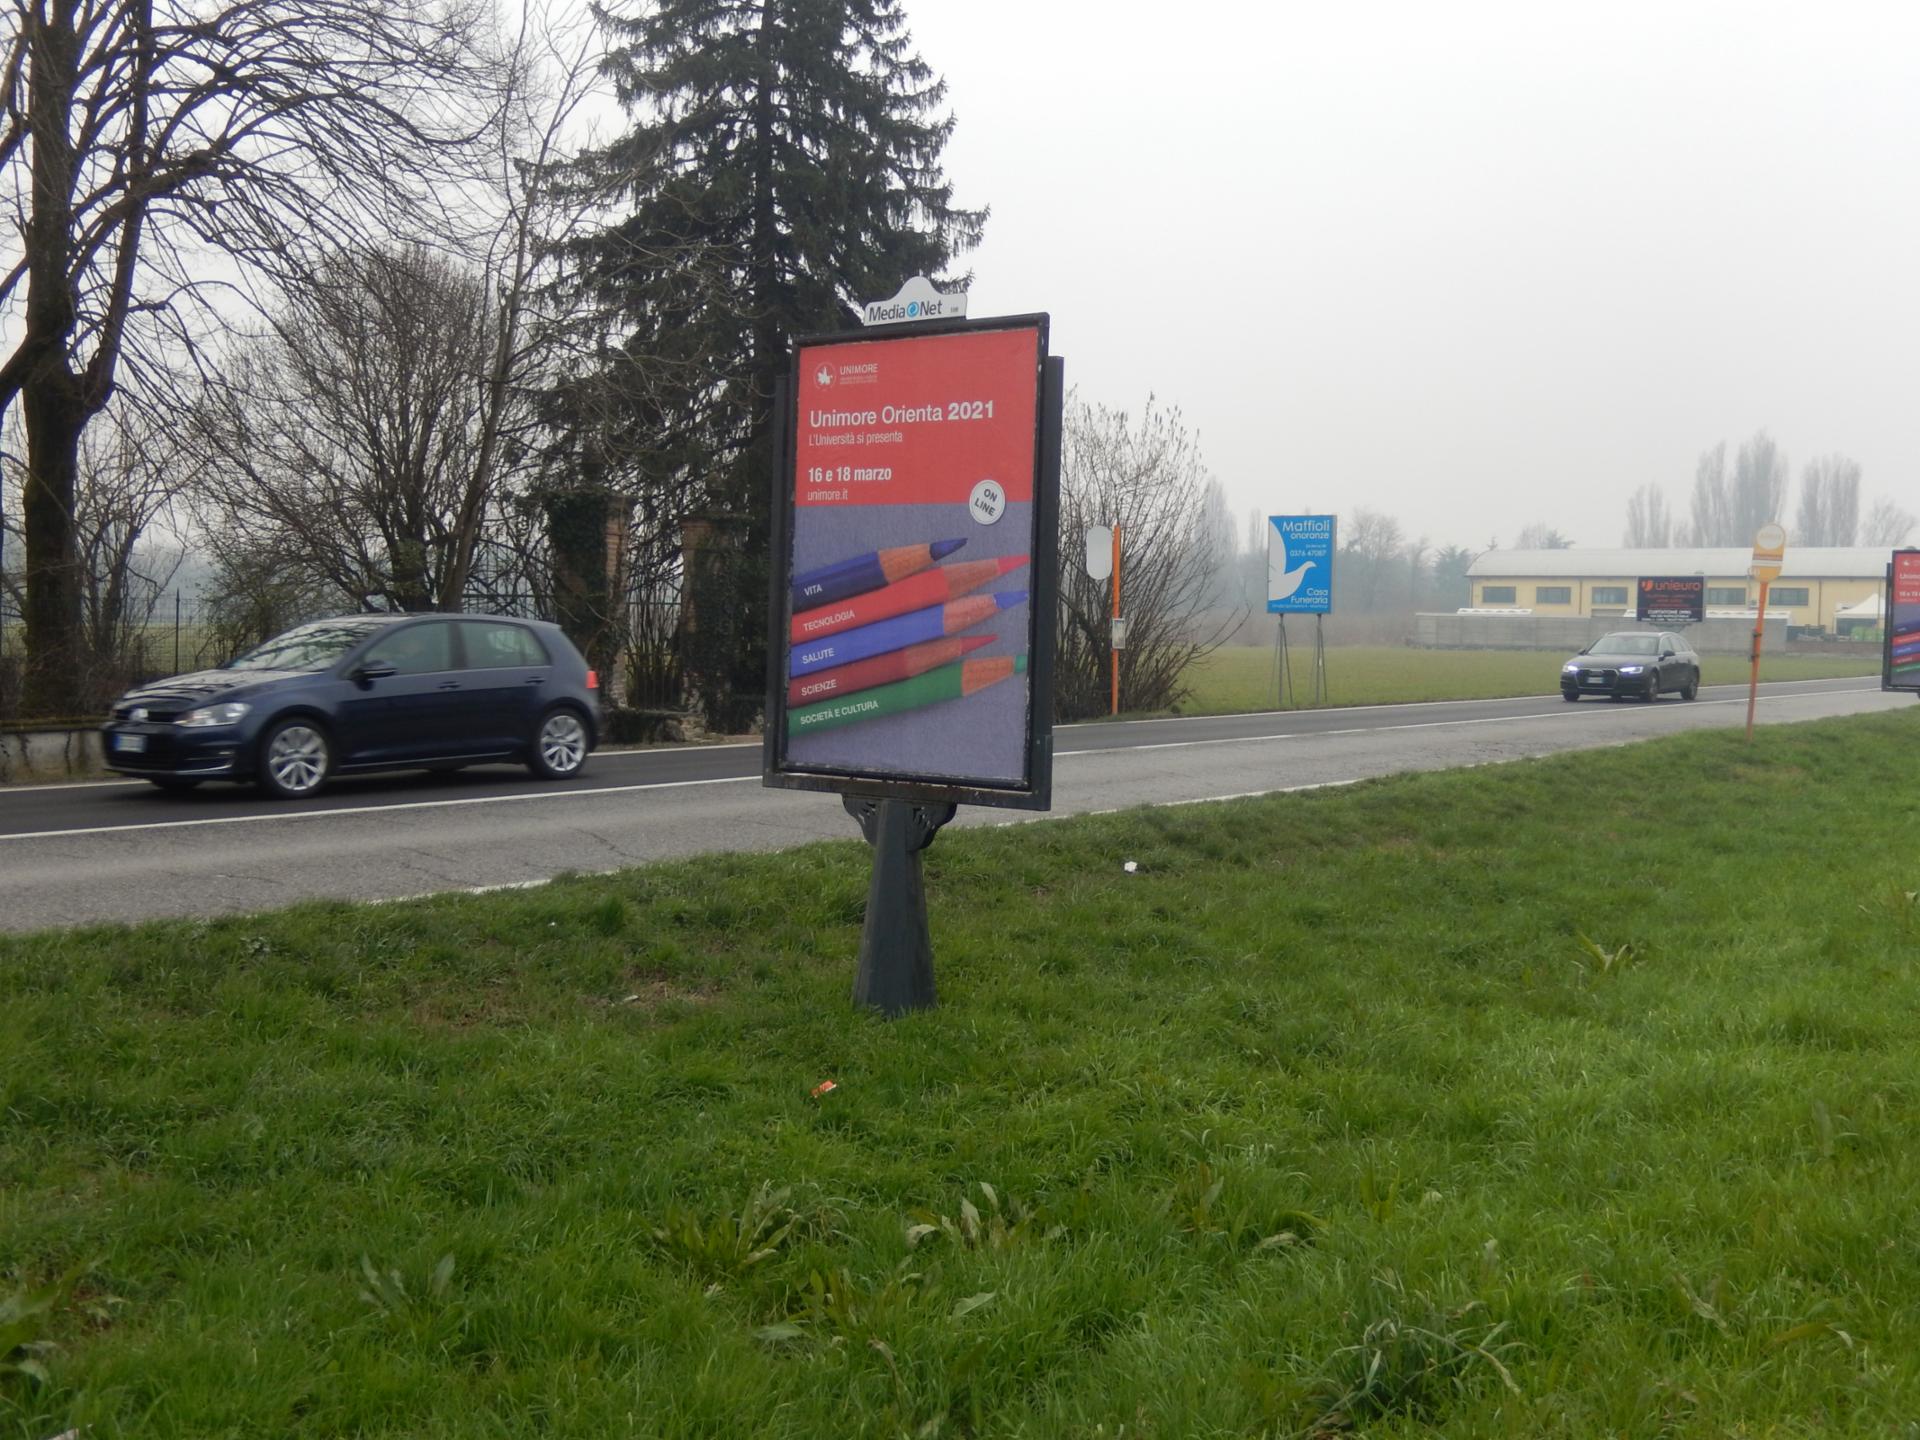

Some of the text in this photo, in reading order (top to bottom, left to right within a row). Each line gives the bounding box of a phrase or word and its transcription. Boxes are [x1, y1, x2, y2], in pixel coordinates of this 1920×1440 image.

[868, 304, 905, 322] Media
[920, 300, 942, 316] Net
[840, 363, 879, 375] UNIMORE
[810, 400, 994, 428] Unimore Orienta 2021
[809, 431, 903, 446] L'Università si presenta
[808, 466, 892, 482] 16 e 18 marzo
[807, 488, 848, 501] unimore.it
[984, 488, 998, 502] ON
[974, 498, 996, 516] LINE
[1282, 519, 1330, 532] Maffioli
[1291, 531, 1329, 540] onoranze
[804, 584, 823, 597] VITA
[1306, 587, 1328, 596] Casa
[1655, 580, 1702, 591] unieuro
[1290, 595, 1328, 604] Funeraria
[803, 610, 855, 631] TECNOLOGIA
[802, 647, 835, 664] SALUTE
[801, 679, 838, 697] SCIENZE
[800, 700, 879, 725] SOCIETÀ E CULTURA
